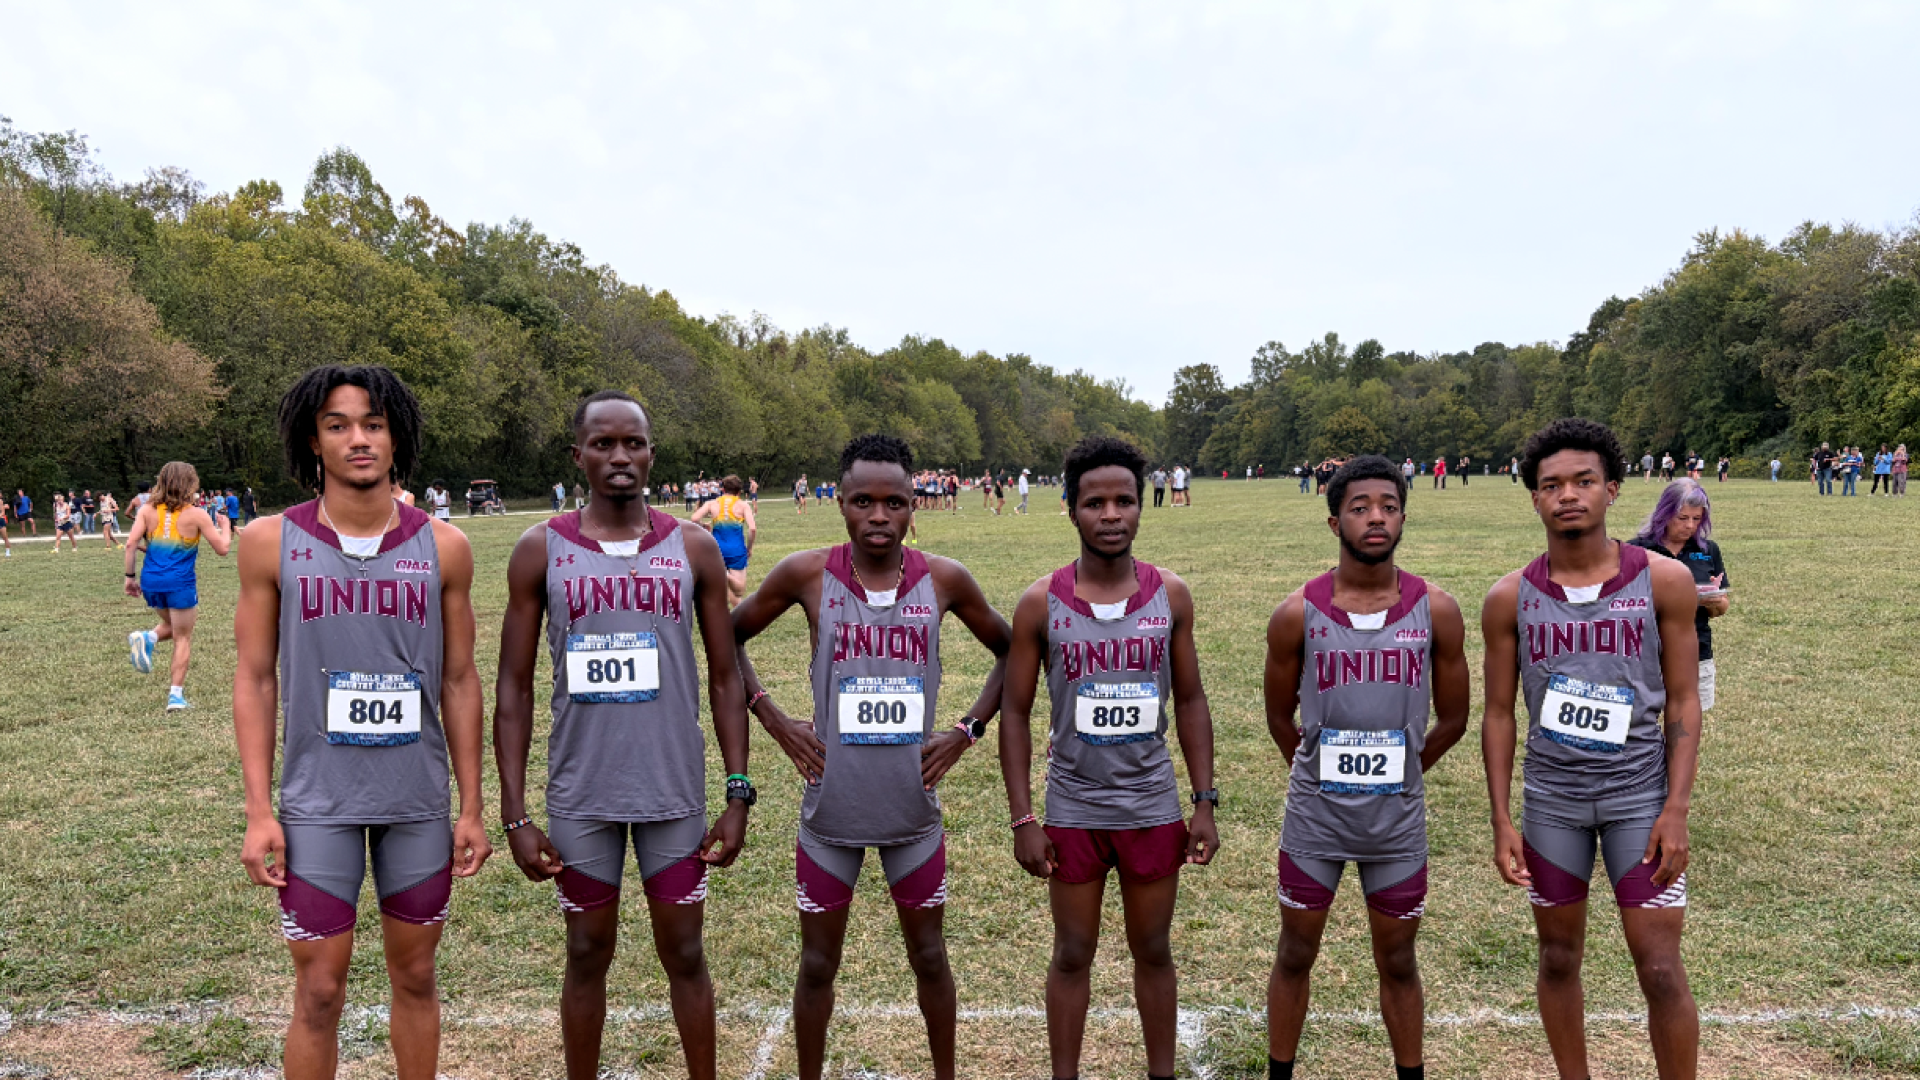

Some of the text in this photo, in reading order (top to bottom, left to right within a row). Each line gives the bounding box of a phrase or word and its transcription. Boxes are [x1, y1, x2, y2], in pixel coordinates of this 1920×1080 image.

[394, 558, 432, 574] CIAA
[649, 555, 685, 571] CIAA
[296, 575, 428, 629] UNION
[562, 575, 681, 624] UNION
[1608, 597, 1648, 611] CIAA
[833, 621, 929, 668] UNION
[1526, 617, 1645, 666] UNION
[586, 657, 637, 684] 801
[1060, 635, 1165, 684] UNION
[1313, 647, 1425, 695] UNION
[348, 697, 404, 725] 804
[857, 699, 907, 725] 800
[1092, 705, 1140, 728] 803
[1558, 701, 1610, 732] 805
[1337, 752, 1388, 776] 802
